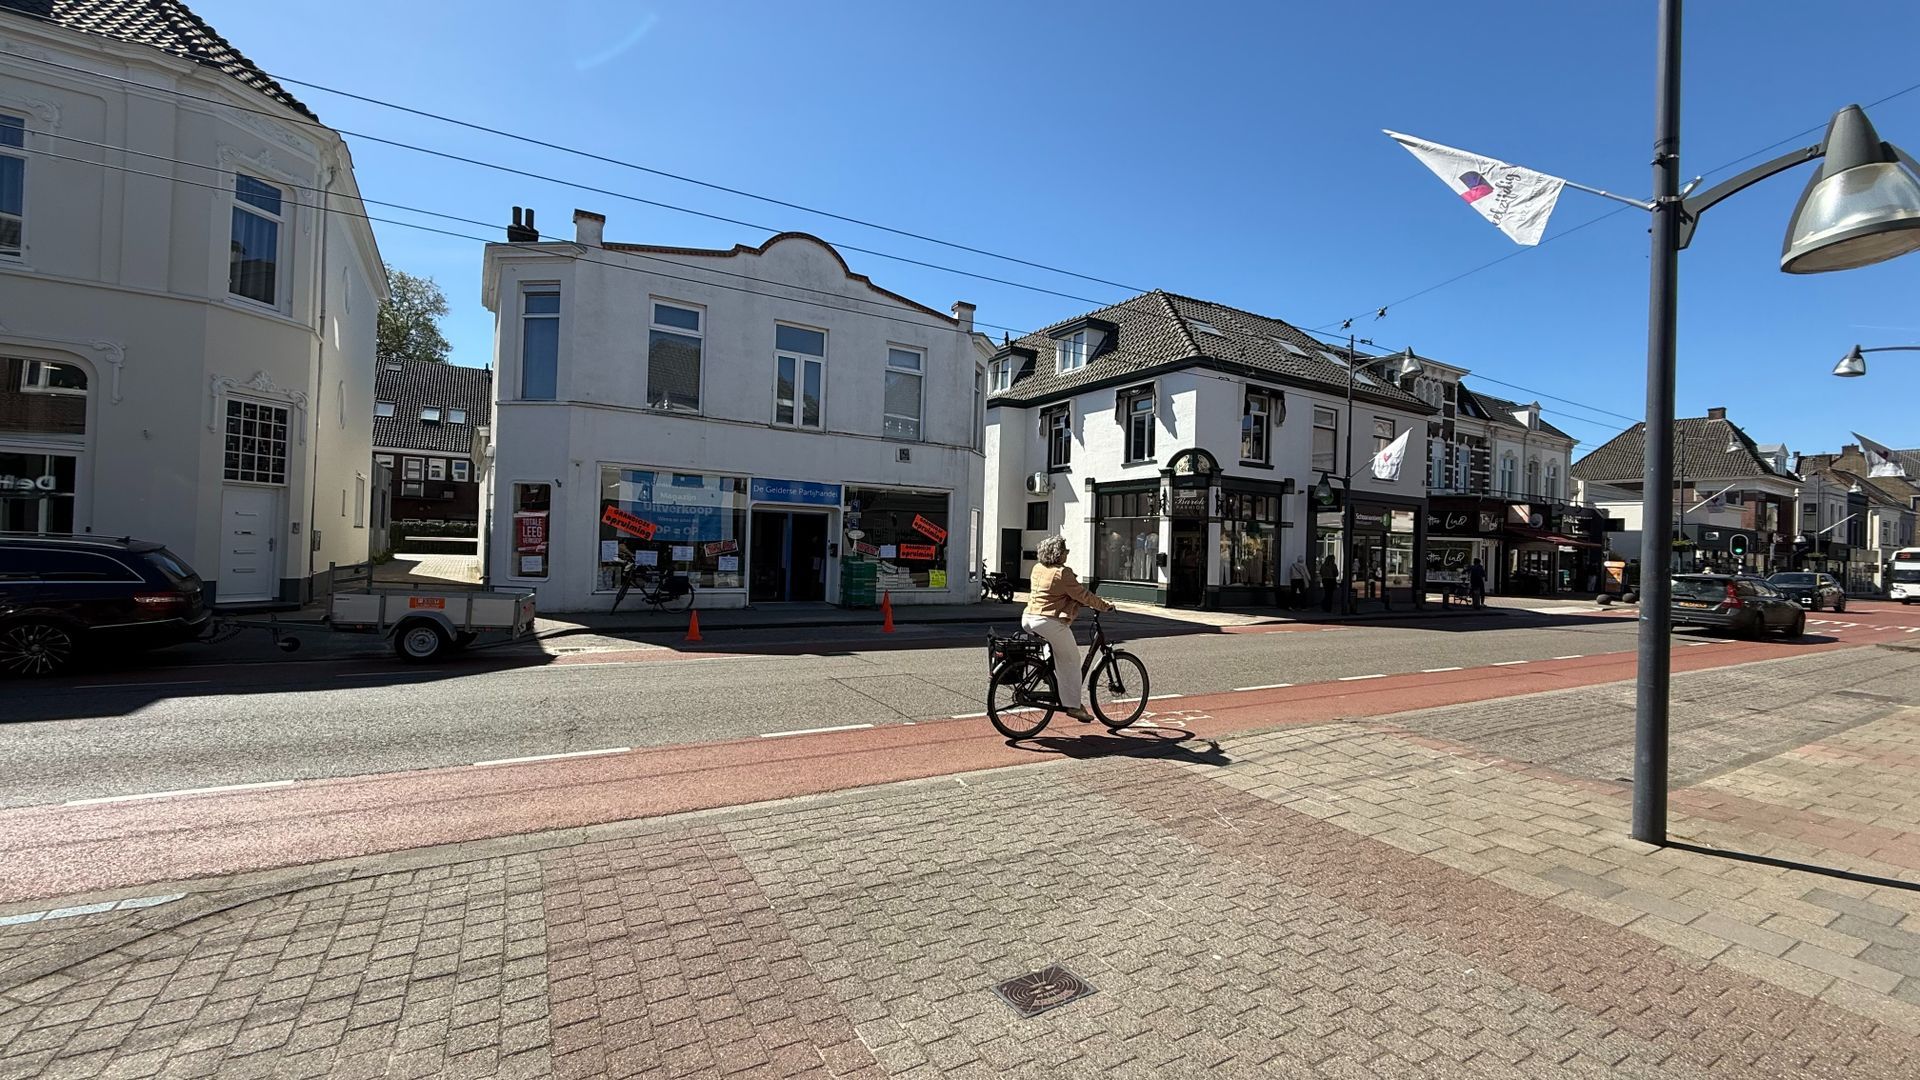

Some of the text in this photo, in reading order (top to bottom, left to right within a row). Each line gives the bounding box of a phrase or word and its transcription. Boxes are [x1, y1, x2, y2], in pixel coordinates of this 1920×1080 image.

[753, 485, 838, 498] De Gelderse Partijhandel
[643, 503, 713, 515] Uitverkoop
[522, 526, 543, 538] LEEG
[605, 515, 652, 539] opruiming
